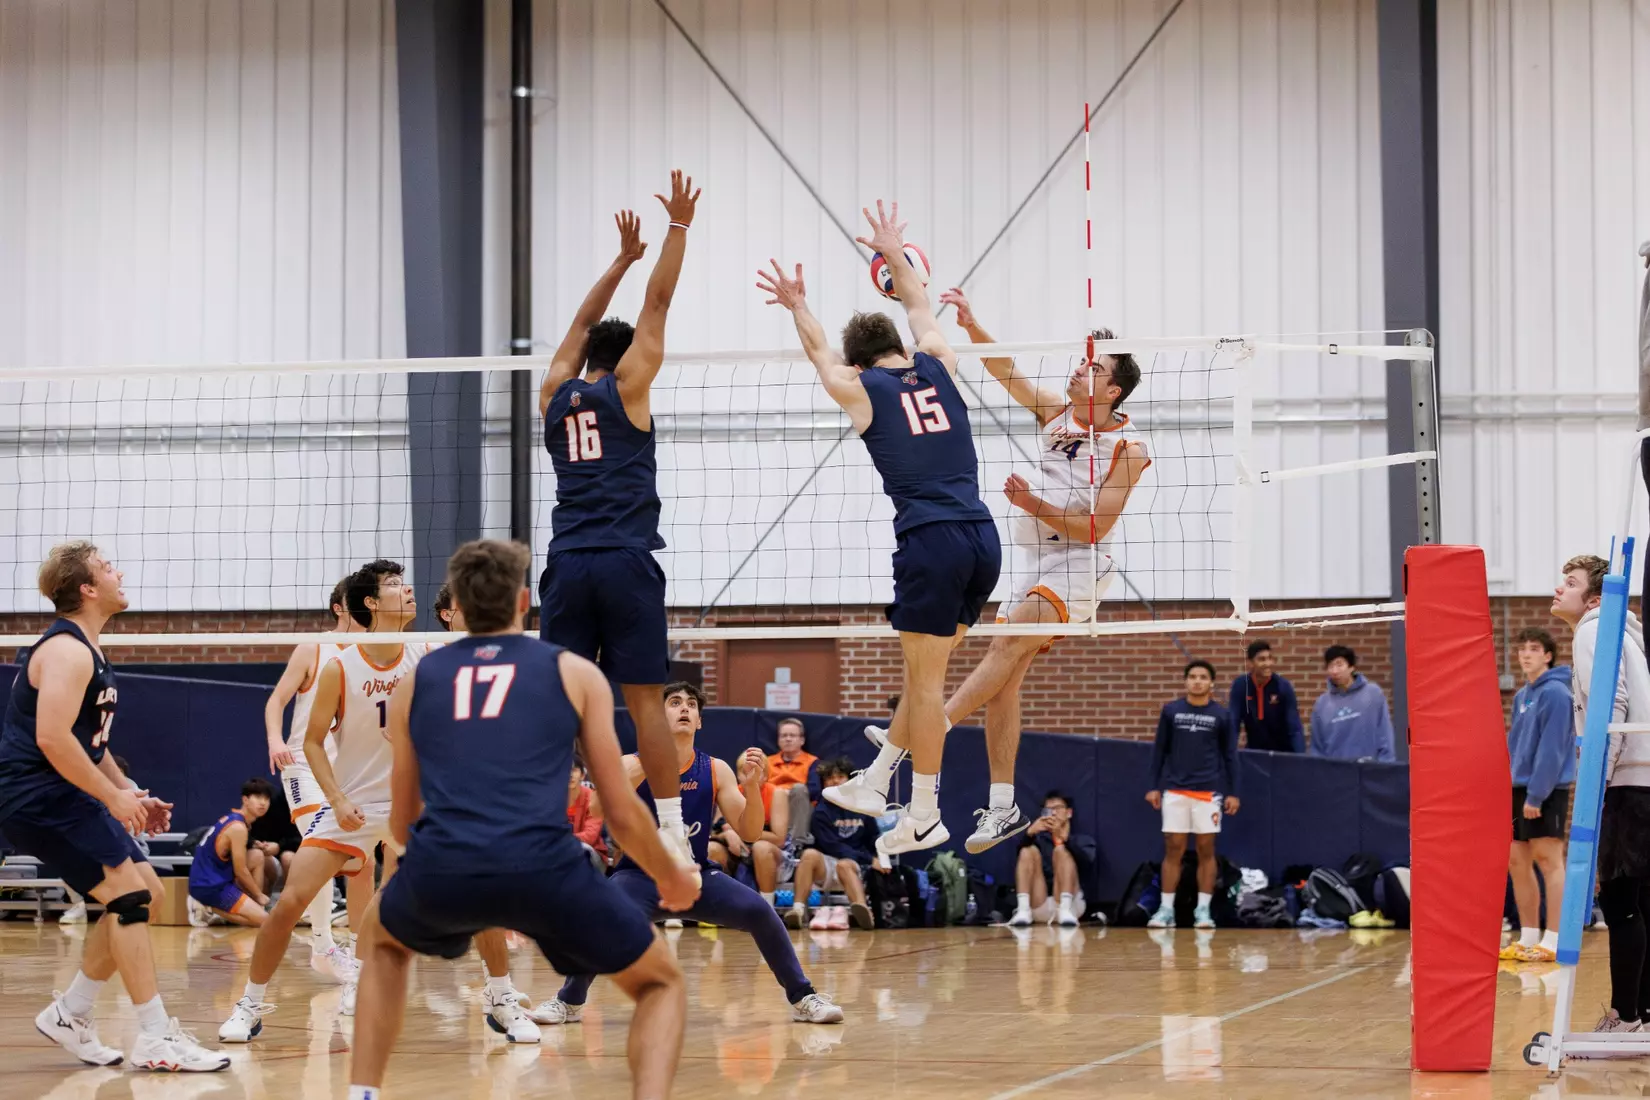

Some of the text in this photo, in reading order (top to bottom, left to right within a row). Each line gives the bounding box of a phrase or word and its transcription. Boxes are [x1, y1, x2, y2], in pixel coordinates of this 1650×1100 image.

[564, 410, 603, 462] 16
[899, 385, 952, 436] 15
[1050, 439, 1085, 461] 14
[453, 662, 517, 721] 17
